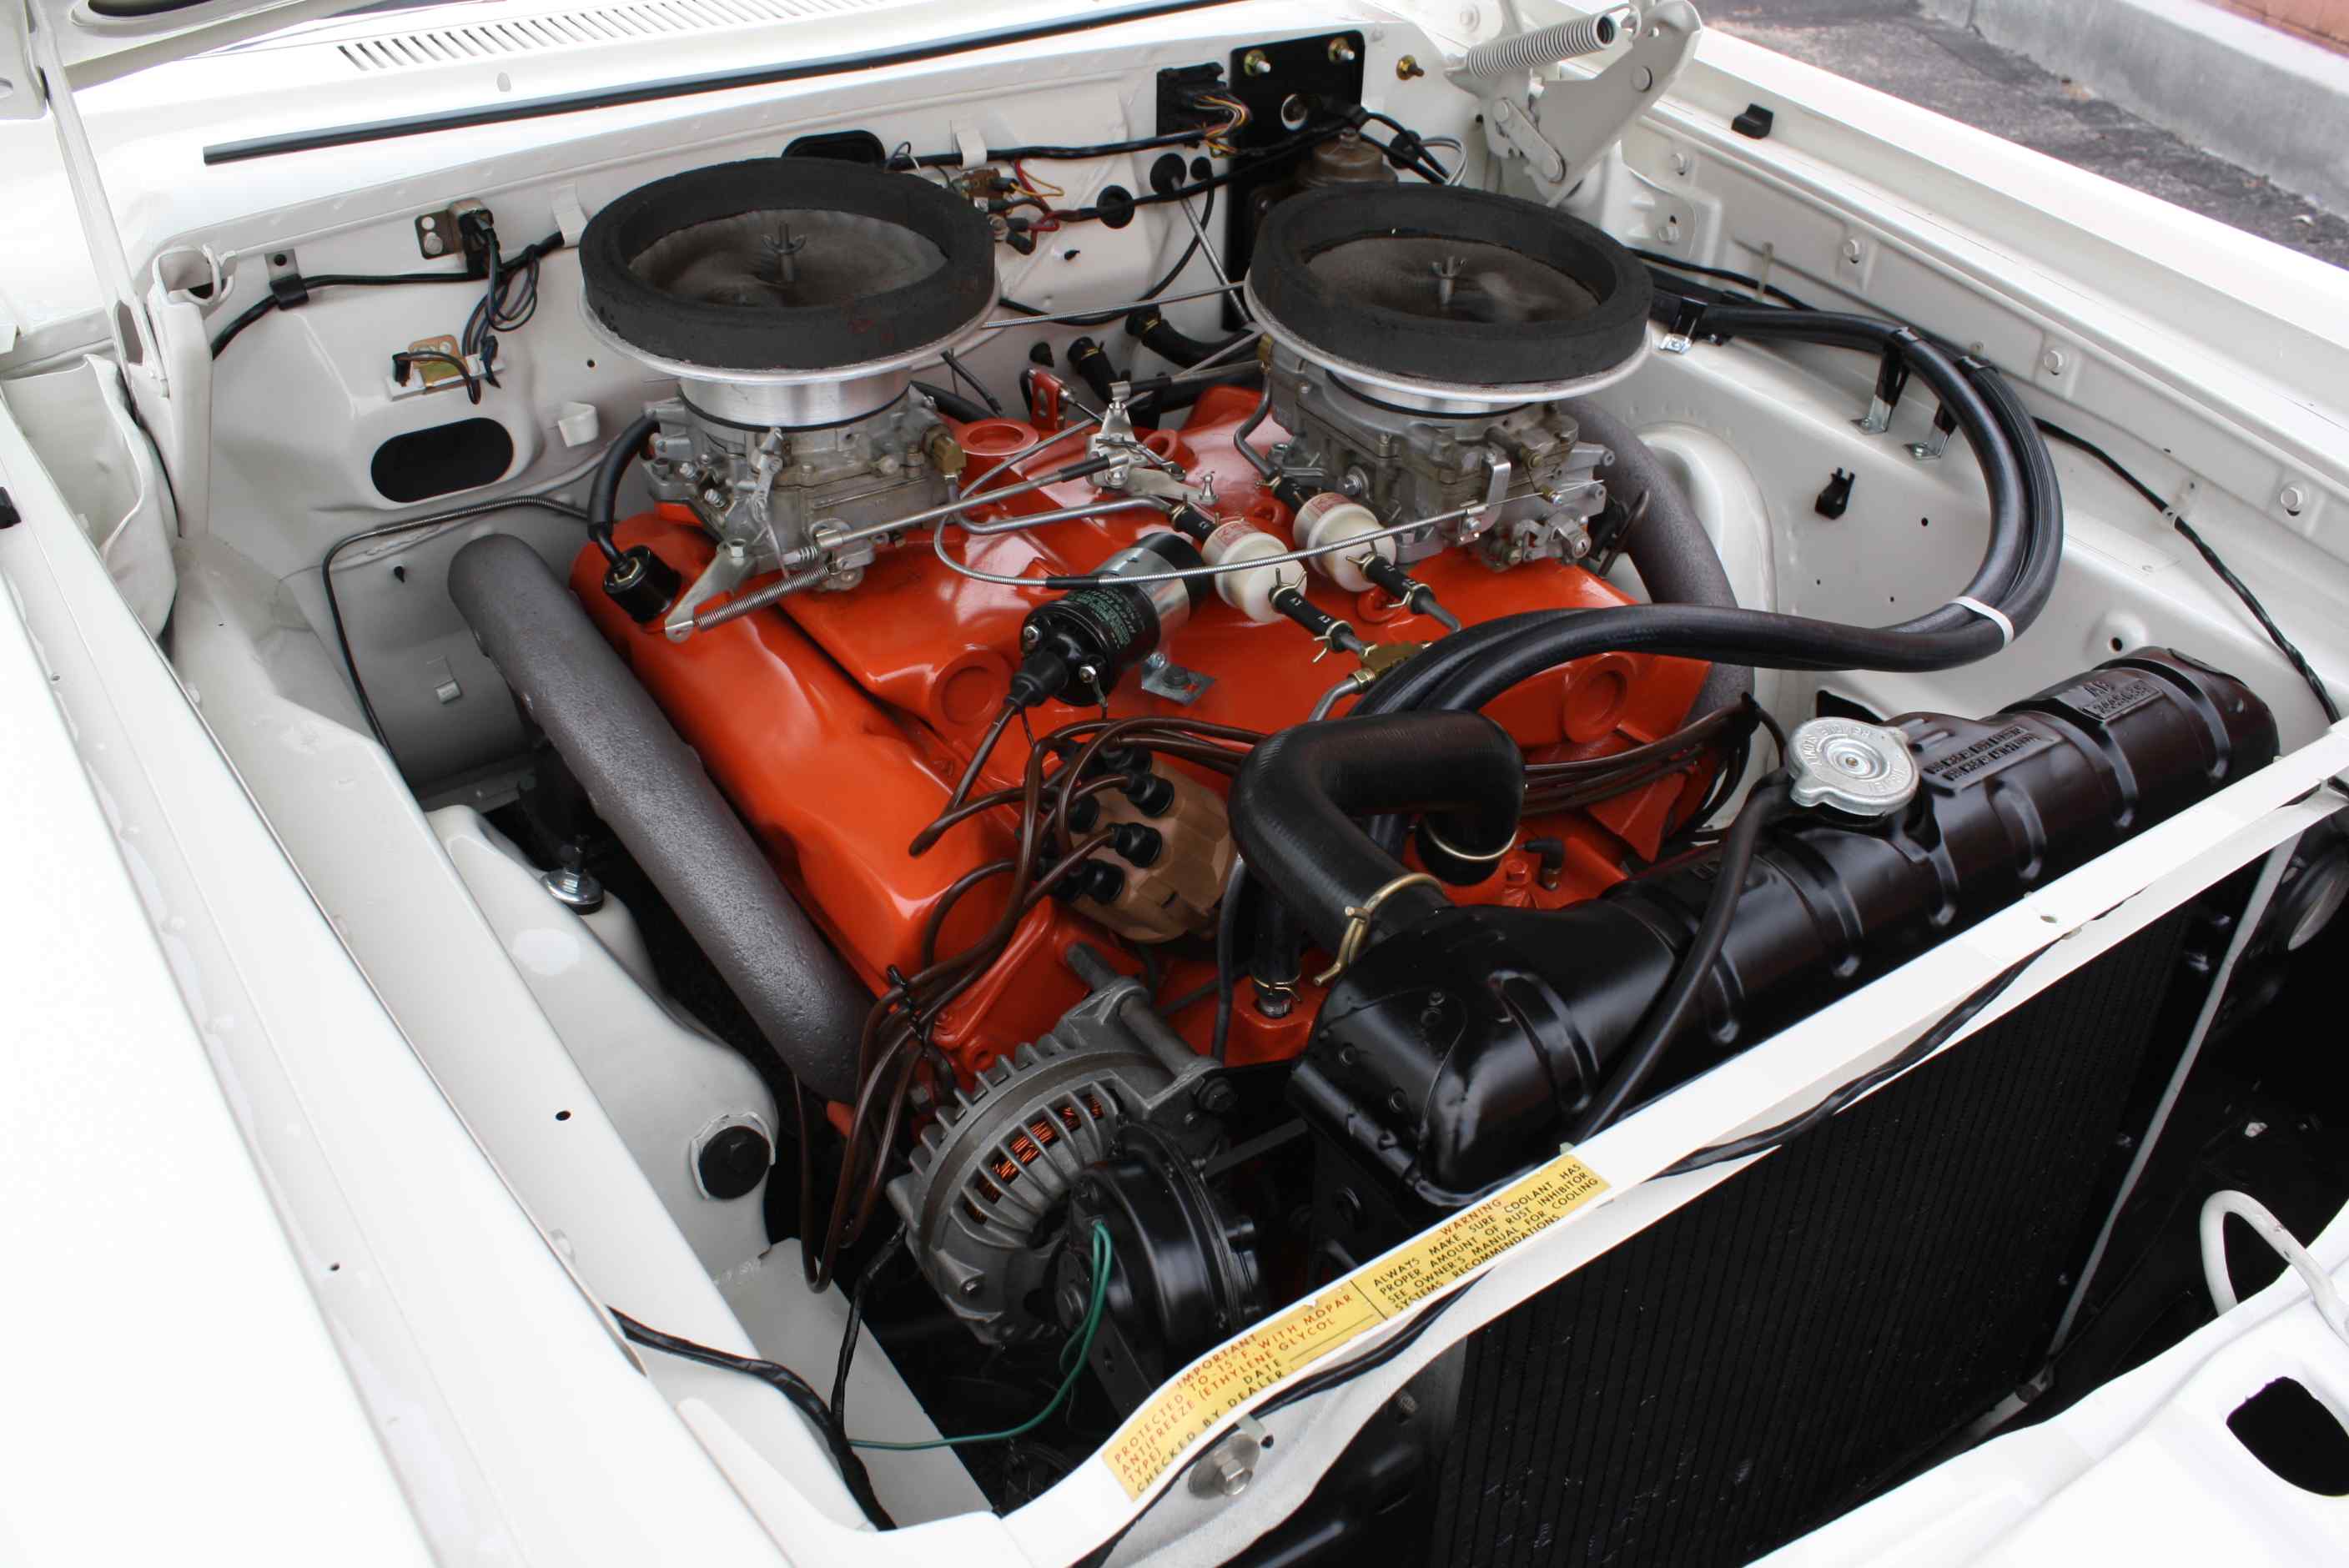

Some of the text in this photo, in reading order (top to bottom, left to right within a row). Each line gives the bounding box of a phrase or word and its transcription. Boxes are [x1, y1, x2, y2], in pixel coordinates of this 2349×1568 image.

[1373, 1163, 1582, 1287] ALWAYS MAKE SURE COOLANT HAS
[1379, 1172, 1588, 1295] PROPER AMOUNT OF RUST INHIBITOR
[1387, 1177, 1599, 1304] SEE OWNER'S MANUAL FOR COOLING
[1441, 1199, 1502, 1236] WARNING
[1395, 1280, 1444, 1310] SYSTEMS
[1114, 1394, 1183, 1464] PROTECTED
[1190, 1375, 1208, 1391] TO
[1258, 1324, 1297, 1349] WITH
[1304, 1294, 1352, 1325] MOPAR
[1122, 1319, 1335, 1475] ANTIFREEZE (ETHYLENE GLYCOL
[1176, 1334, 1256, 1388] IMPORTANT
[1243, 1359, 1282, 1385] DATE
[1129, 1446, 1161, 1483] TYPE)
[1137, 1370, 1284, 1492] CHECKED BY DEALER
